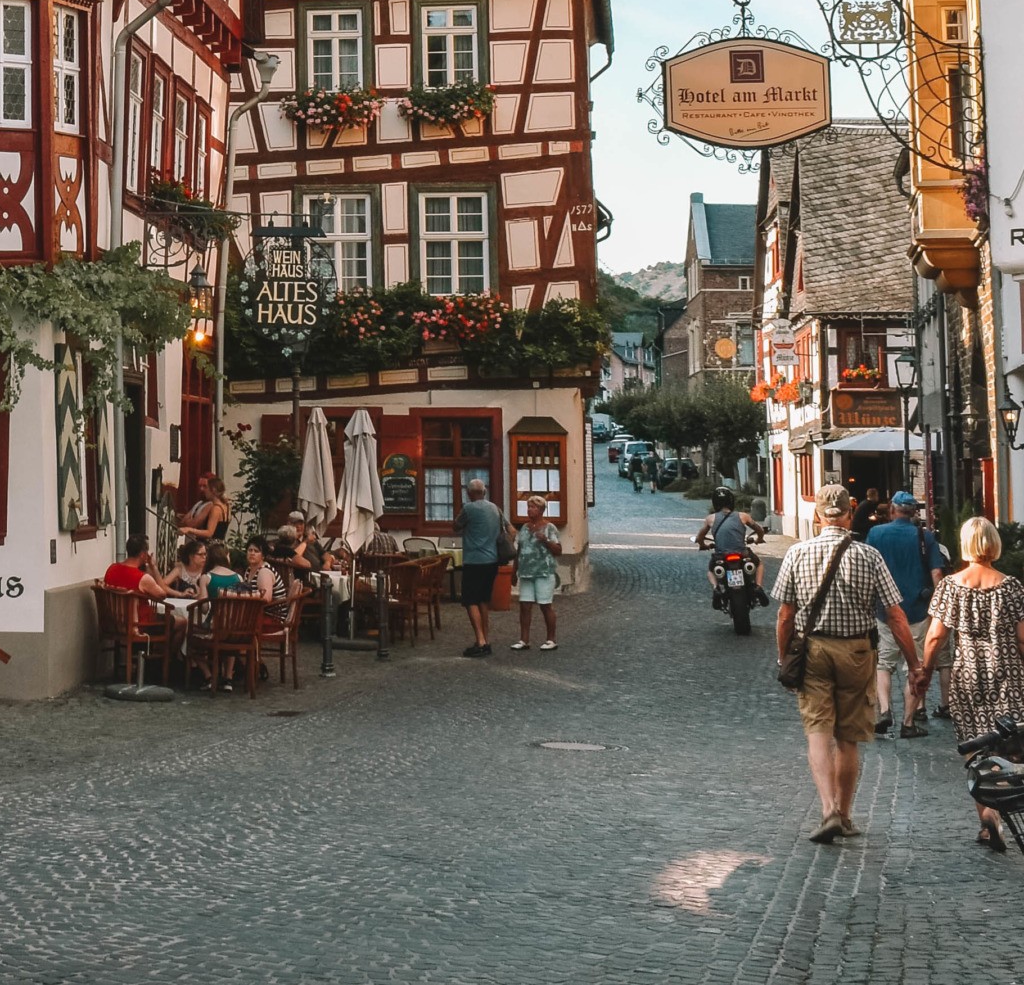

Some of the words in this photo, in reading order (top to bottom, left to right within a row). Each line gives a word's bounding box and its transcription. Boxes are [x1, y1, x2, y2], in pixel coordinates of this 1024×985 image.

[678, 88, 725, 106] Hotel
[732, 91, 757, 103] am
[763, 86, 818, 104] Markt
[570, 203, 593, 215] 1579
[273, 250, 301, 264] WEIN
[272, 264, 304, 278] HAUS
[256, 281, 318, 303] ALTES
[257, 303, 317, 325] HAUS
